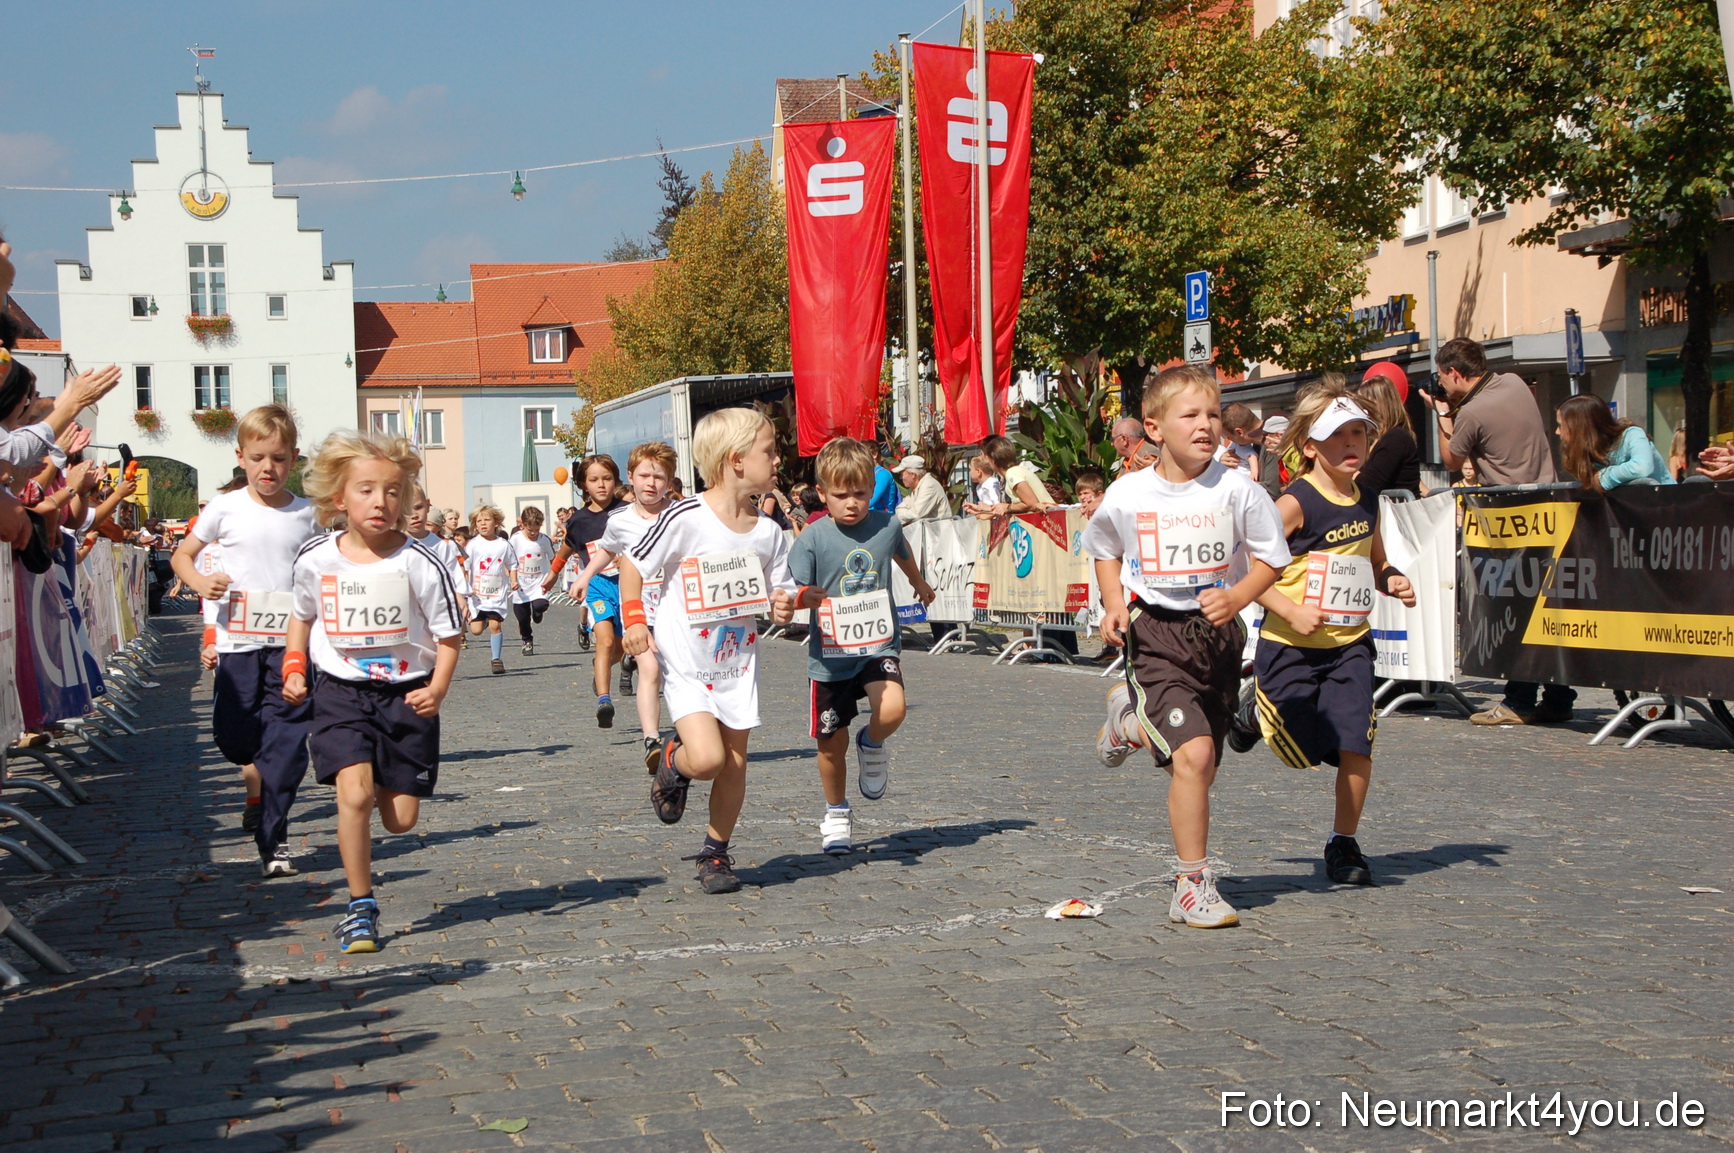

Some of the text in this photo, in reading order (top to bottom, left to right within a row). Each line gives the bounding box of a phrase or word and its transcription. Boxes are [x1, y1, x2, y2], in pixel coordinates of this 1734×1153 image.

[1191, 279, 1203, 315] P
[1325, 519, 1369, 543] adidas
[1165, 541, 1225, 566] 7168
[1609, 527, 1645, 569] Tel.:
[1650, 526, 1705, 570] 09181
[702, 557, 747, 574] Benedikt
[1331, 561, 1356, 576] Carlo
[341, 581, 366, 595] Felix
[686, 583, 697, 592] K2
[708, 577, 760, 602] 7135
[1308, 580, 1319, 590] K2
[1330, 586, 1371, 607] 7148
[324, 602, 334, 613] K2
[344, 605, 402, 627] 7162
[836, 600, 879, 615] Jonathan
[822, 621, 831, 630] K2
[840, 618, 888, 641] 7076
[1542, 617, 1599, 639] Neumarkt
[696, 667, 739, 681] neumarkt
